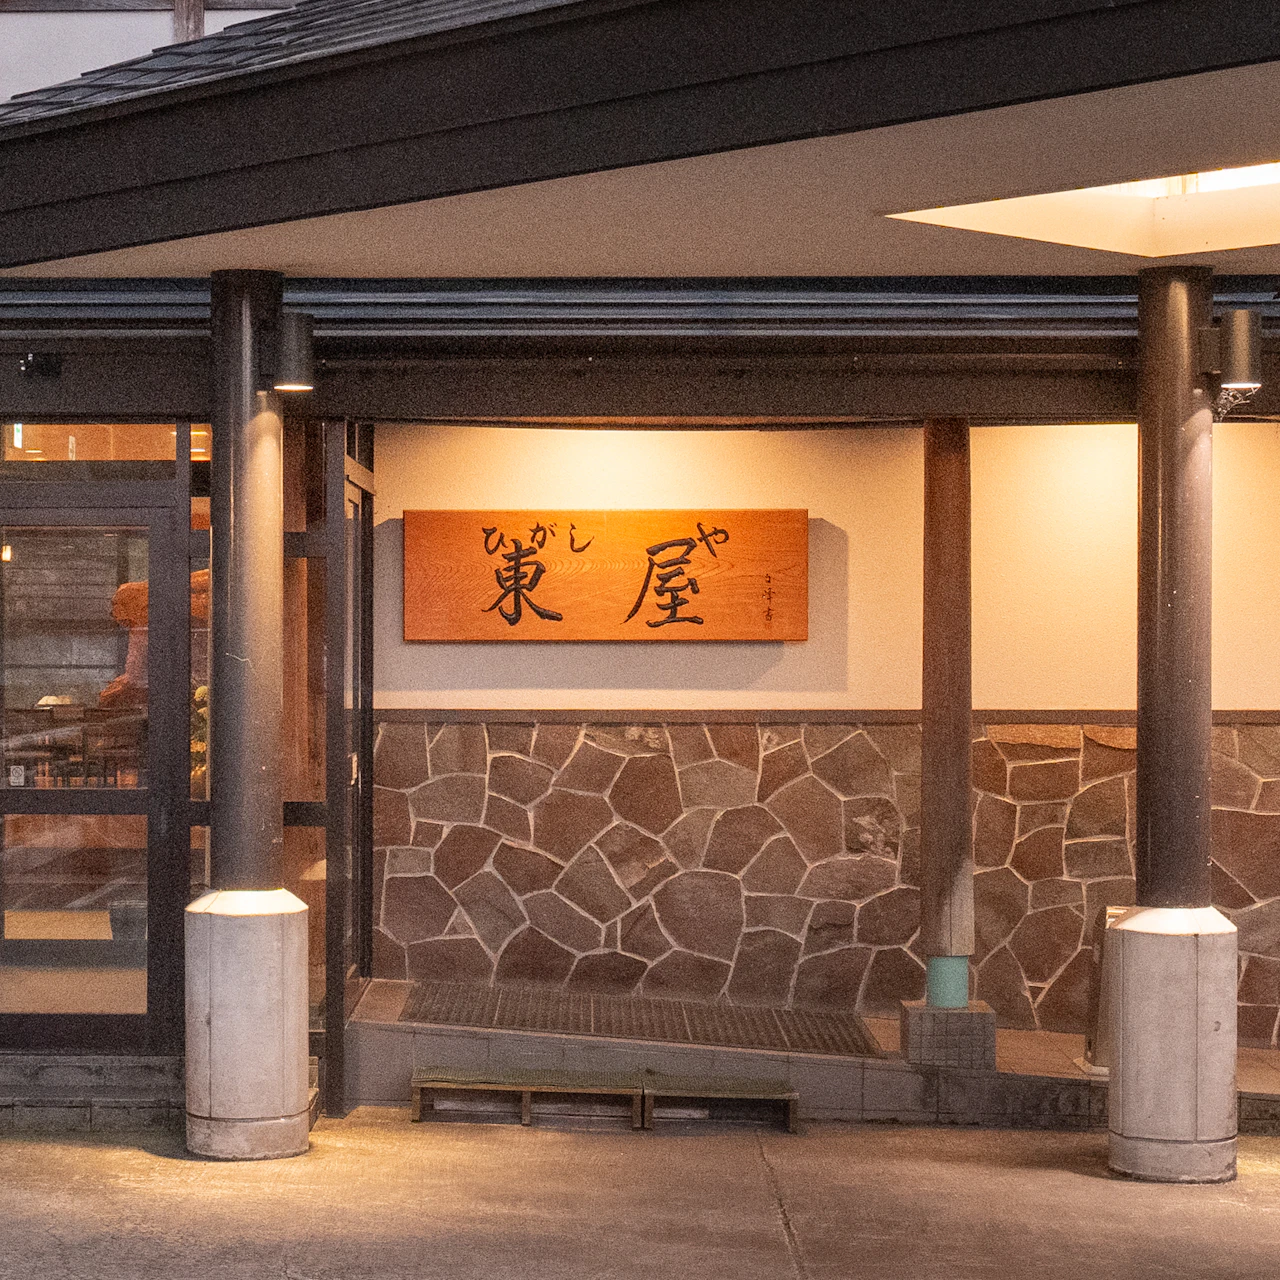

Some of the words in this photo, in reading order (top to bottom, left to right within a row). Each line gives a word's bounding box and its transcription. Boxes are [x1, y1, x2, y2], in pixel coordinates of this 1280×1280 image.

[482, 522, 595, 555] ひがし
[697, 522, 729, 558] や
